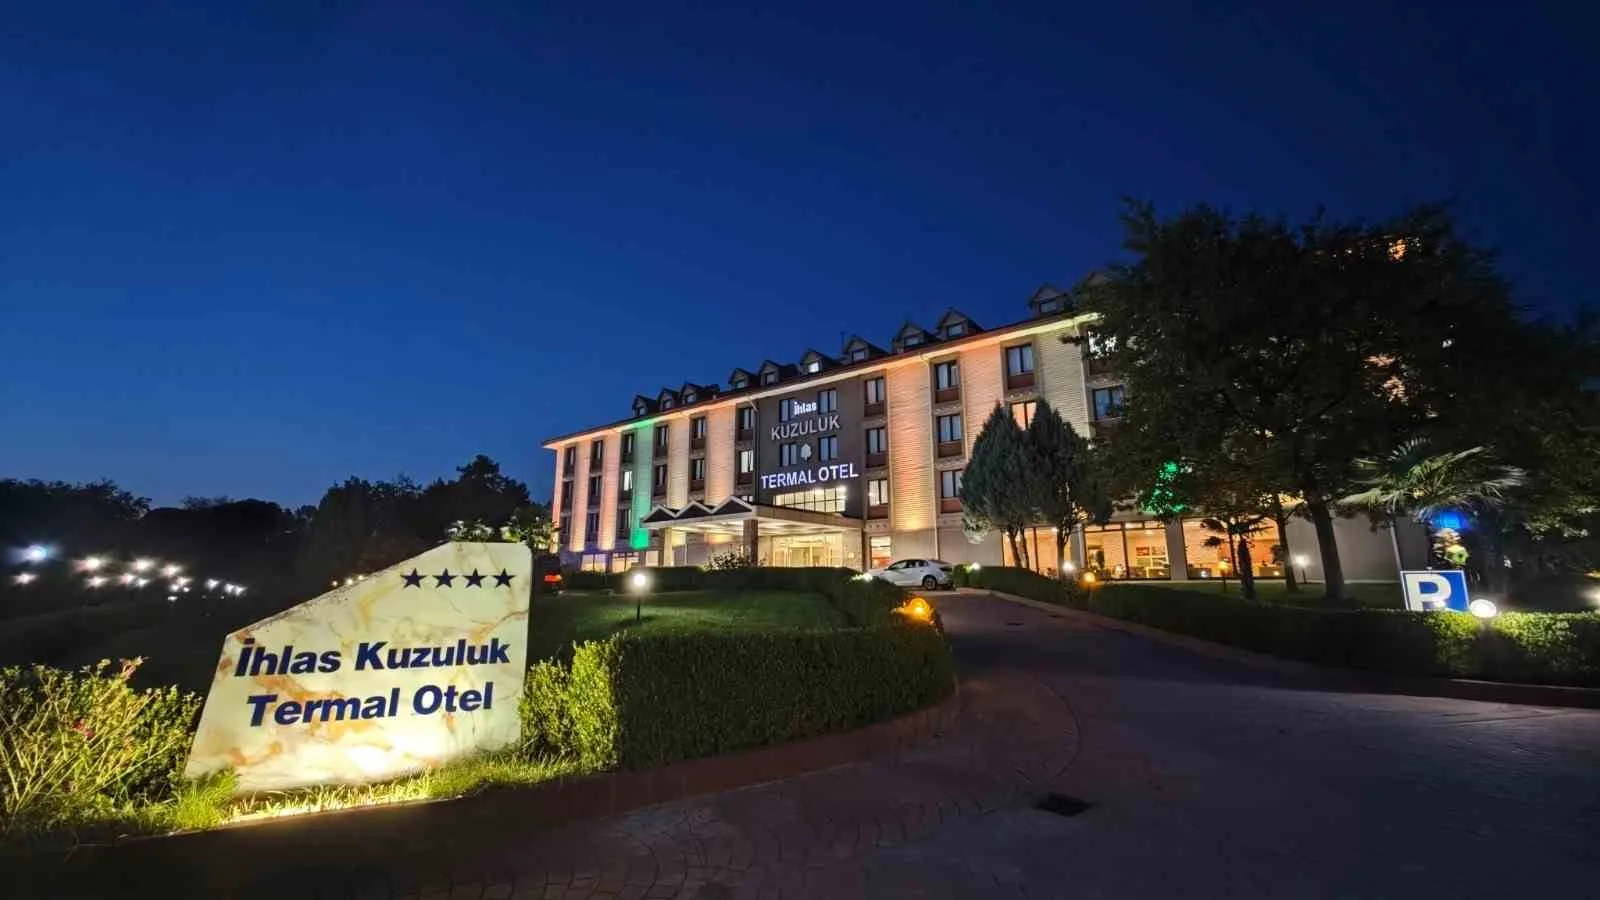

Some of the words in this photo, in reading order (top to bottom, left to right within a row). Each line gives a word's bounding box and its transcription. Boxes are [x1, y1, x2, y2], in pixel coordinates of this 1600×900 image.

[771, 415, 840, 440] KUZULUK
[761, 469, 816, 489] TERMAL
[818, 463, 859, 481] OTEL
[1406, 573, 1451, 611] P
[234, 638, 341, 677] İhlas
[355, 637, 510, 671] Kuzuluk
[247, 687, 400, 727] Termal
[412, 681, 494, 716] Otel
